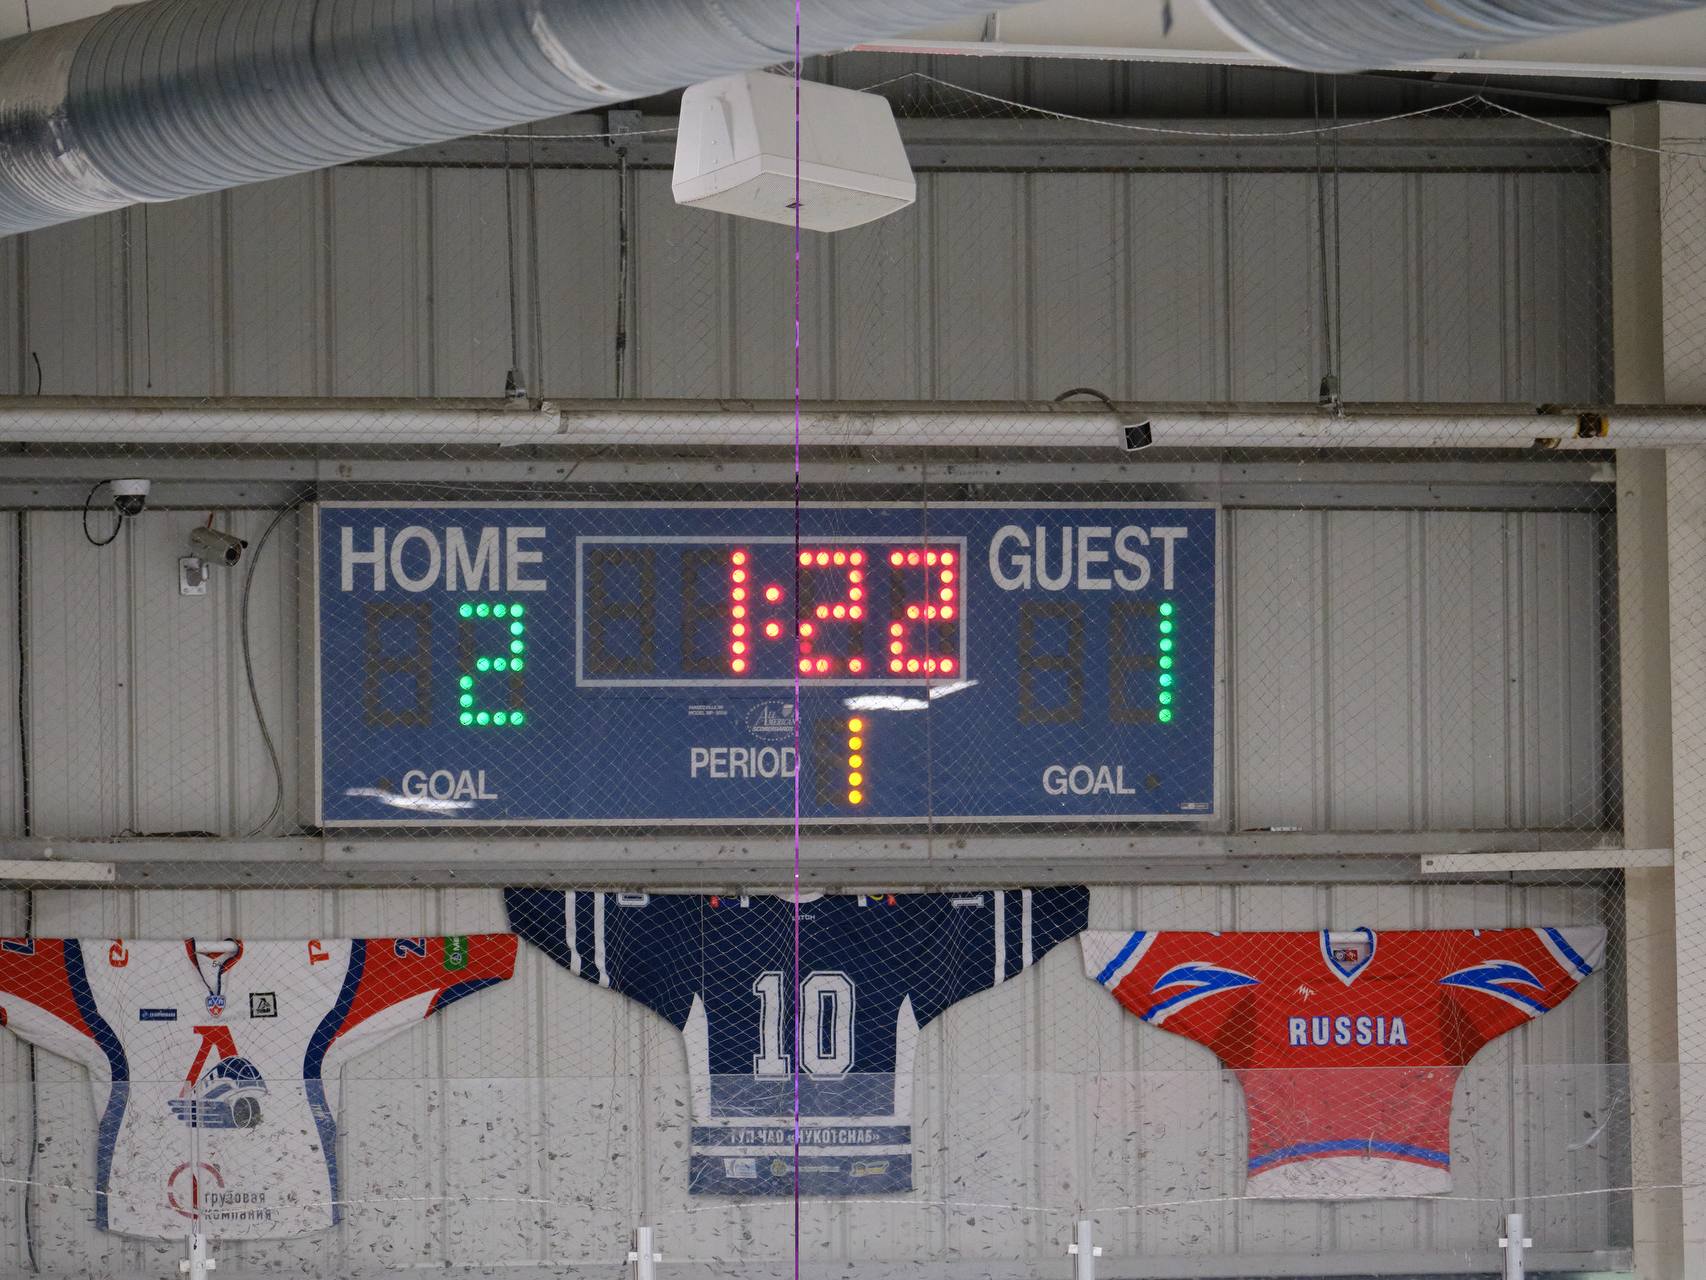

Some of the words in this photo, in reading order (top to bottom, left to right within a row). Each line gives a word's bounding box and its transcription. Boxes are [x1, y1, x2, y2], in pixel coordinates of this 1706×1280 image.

[341, 526, 547, 592] HOME
[989, 525, 1188, 591] GUEST
[731, 551, 956, 673] 1:22
[458, 603, 526, 727] 2
[1158, 602, 1174, 724] 1
[402, 770, 498, 801] GOAL
[690, 747, 800, 779] PERIOD
[847, 717, 864, 806] 1
[1043, 764, 1136, 795] GOAL
[752, 970, 856, 1081] 10
[1288, 1017, 1409, 1047] RUSSIA
